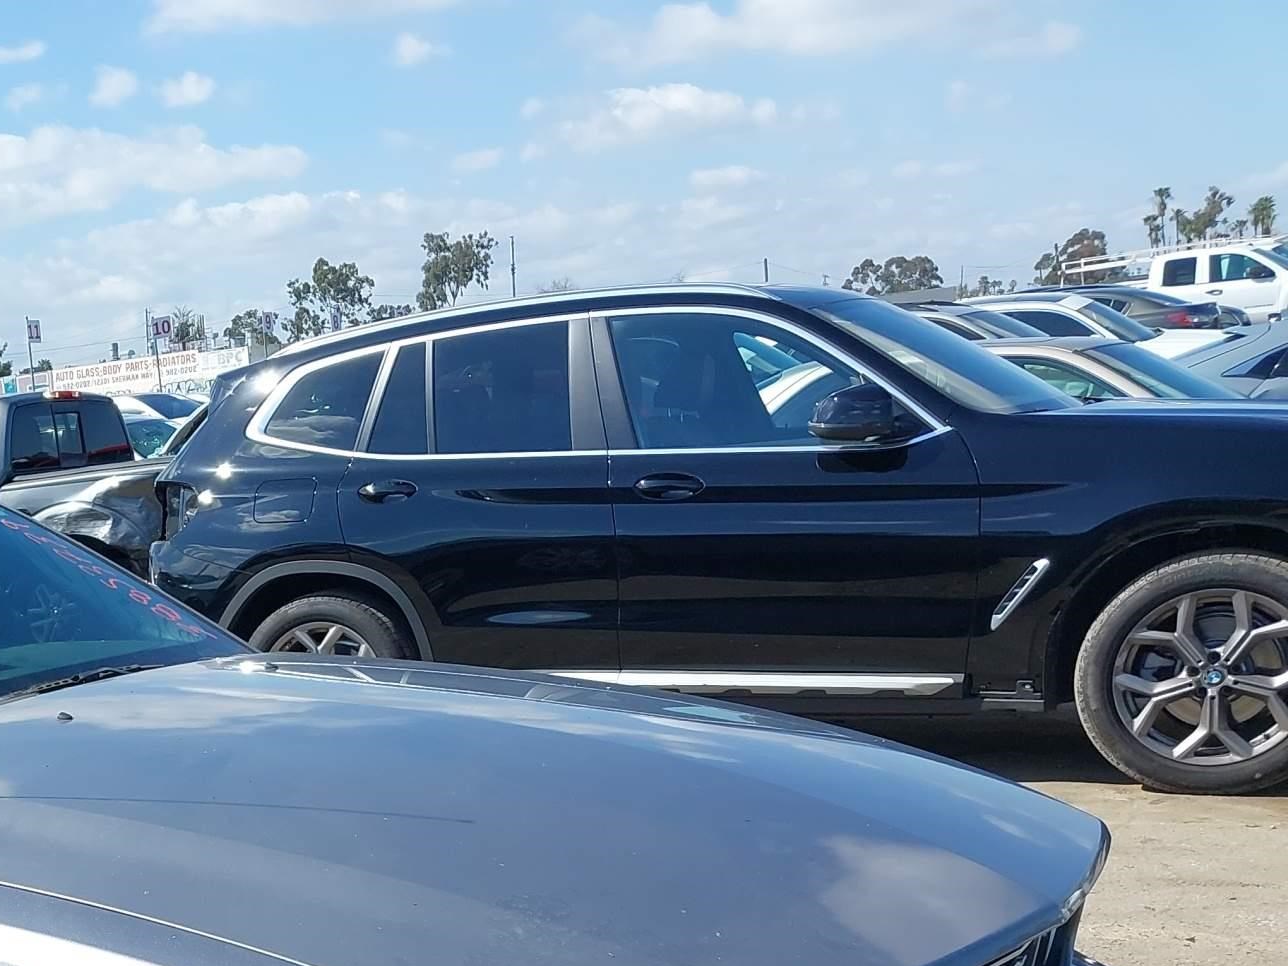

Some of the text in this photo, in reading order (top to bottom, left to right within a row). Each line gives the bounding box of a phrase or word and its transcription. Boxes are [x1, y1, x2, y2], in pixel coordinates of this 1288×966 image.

[152, 319, 170, 336] 10
[265, 314, 272, 330] 9
[27, 324, 40, 339] 11
[55, 371, 74, 383] AUTO
